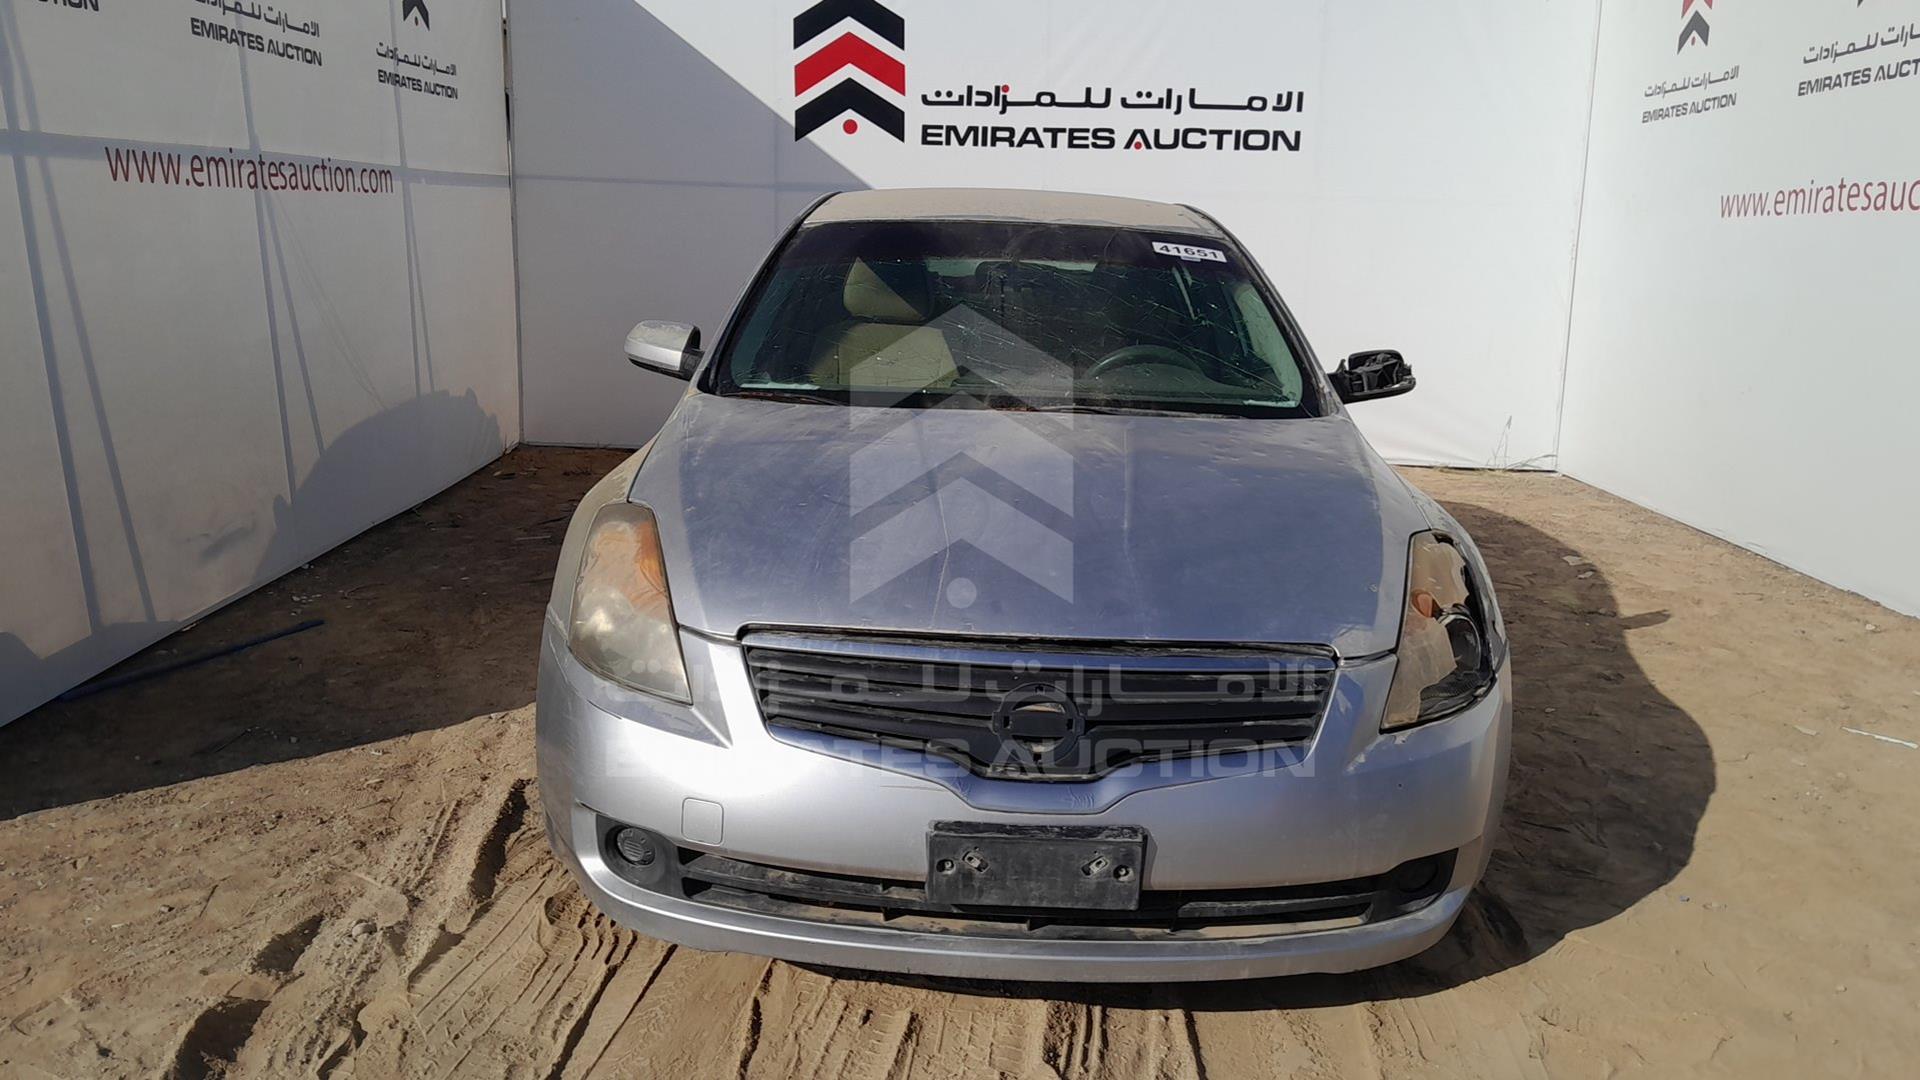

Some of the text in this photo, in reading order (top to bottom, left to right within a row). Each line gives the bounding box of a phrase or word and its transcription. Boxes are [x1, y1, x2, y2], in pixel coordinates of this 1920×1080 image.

[190, 17, 322, 66] EMIRATES AUCTION
[378, 69, 458, 100] EMIRATES AUCTION
[1798, 57, 1920, 97] EMIRATES AUCT
[1641, 92, 1737, 124] EMIRATES AUCTION
[921, 124, 1301, 152] EMIRATES AUCTION
[104, 146, 395, 194] www.emiratesauction.com
[1720, 176, 1920, 219] www.emiratesauc
[1159, 245, 1219, 260] 41651
